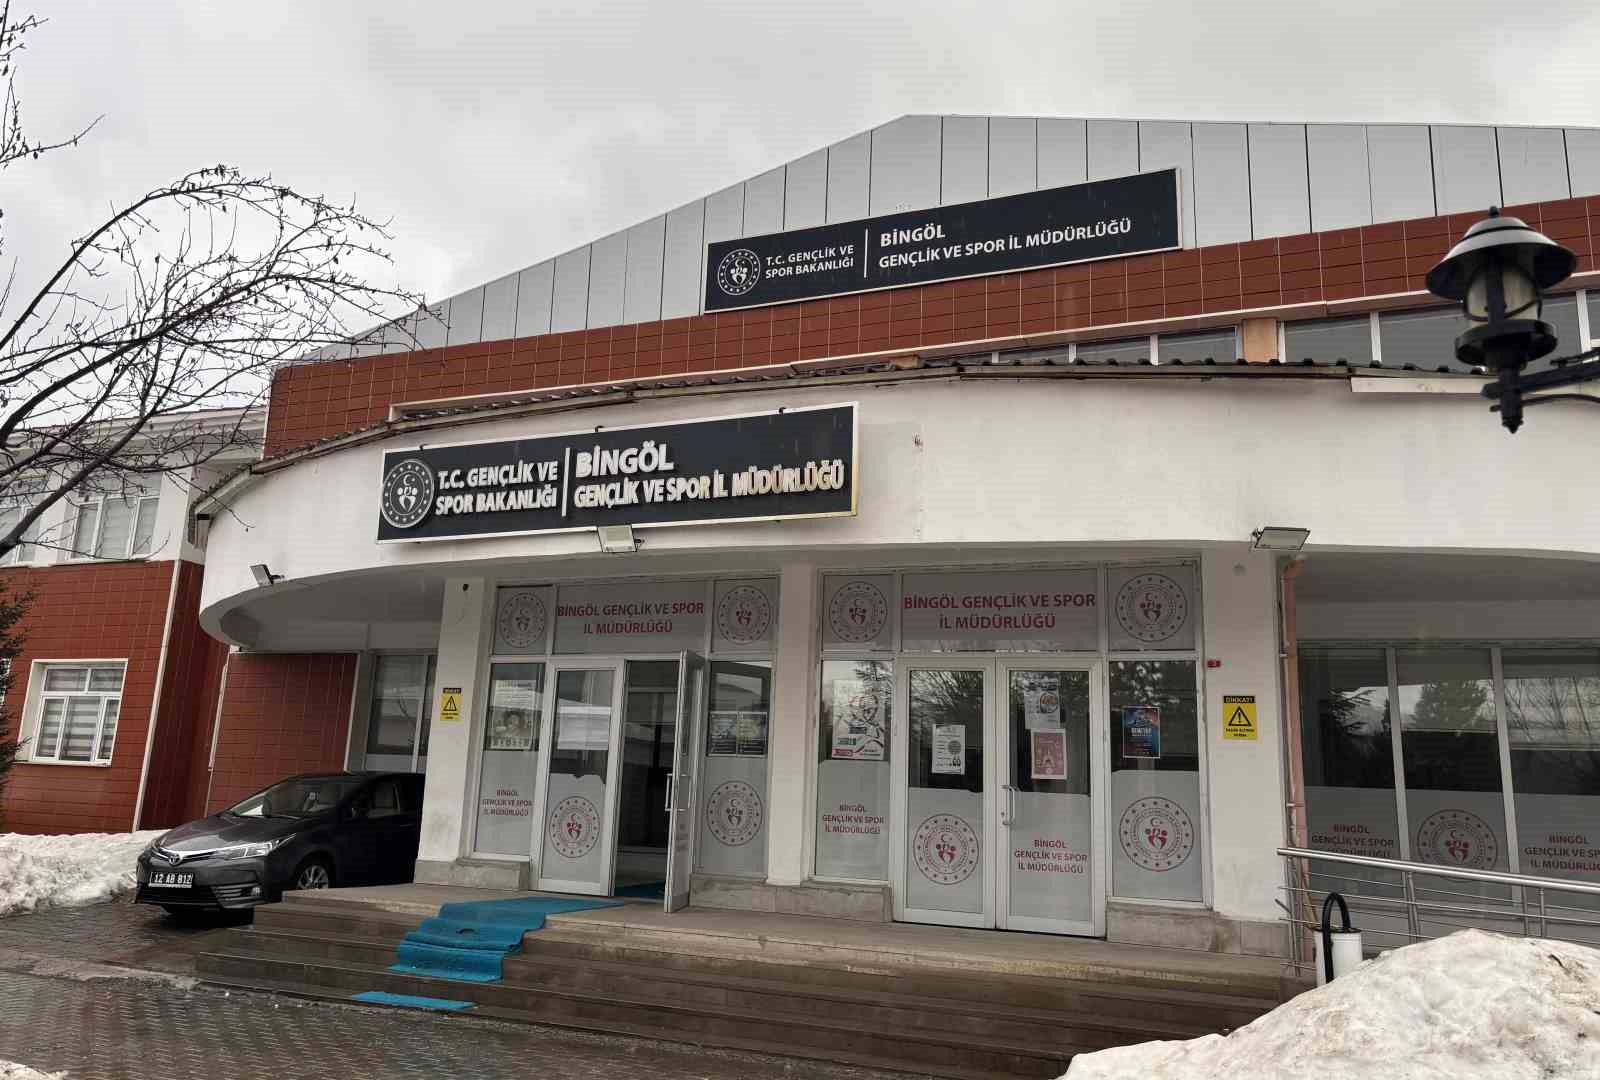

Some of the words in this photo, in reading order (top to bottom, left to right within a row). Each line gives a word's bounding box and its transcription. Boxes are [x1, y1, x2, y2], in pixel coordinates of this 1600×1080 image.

[878, 247, 940, 269] GENÇLİK
[942, 244, 962, 259] VE
[965, 238, 1005, 256] SPOR
[1008, 234, 1023, 250] İL
[1025, 217, 1132, 248] MÜDÜRLÜĞÜ
[880, 222, 946, 248] BİNGÖL
[765, 255, 785, 267] T.C.
[788, 247, 836, 262] GENÇLİK
[839, 244, 855, 256] VE
[765, 266, 793, 280] SPOR
[795, 256, 854, 275] BAKANLIĞI
[575, 440, 675, 478] BİNGÖL
[438, 468, 465, 490] T.C.
[466, 459, 534, 488] GENÇLİK
[537, 460, 559, 482] VE
[574, 476, 641, 509] GENÇLİK
[641, 477, 667, 502] VE
[666, 474, 711, 502] SPOR
[712, 469, 729, 498] İL
[731, 458, 845, 497] MÜDÜRLÜĞÜ
[435, 493, 474, 515] SPOR
[475, 483, 558, 513] BAKANLIĞI
[654, 602, 670, 615] VE
[671, 602, 704, 615] SPOR
[903, 594, 958, 609] BİNGÖL
[962, 593, 1025, 611] GENÇLİK
[1028, 595, 1050, 608] VE
[1053, 593, 1096, 608] SPOR
[154, 873, 164, 884] 12
